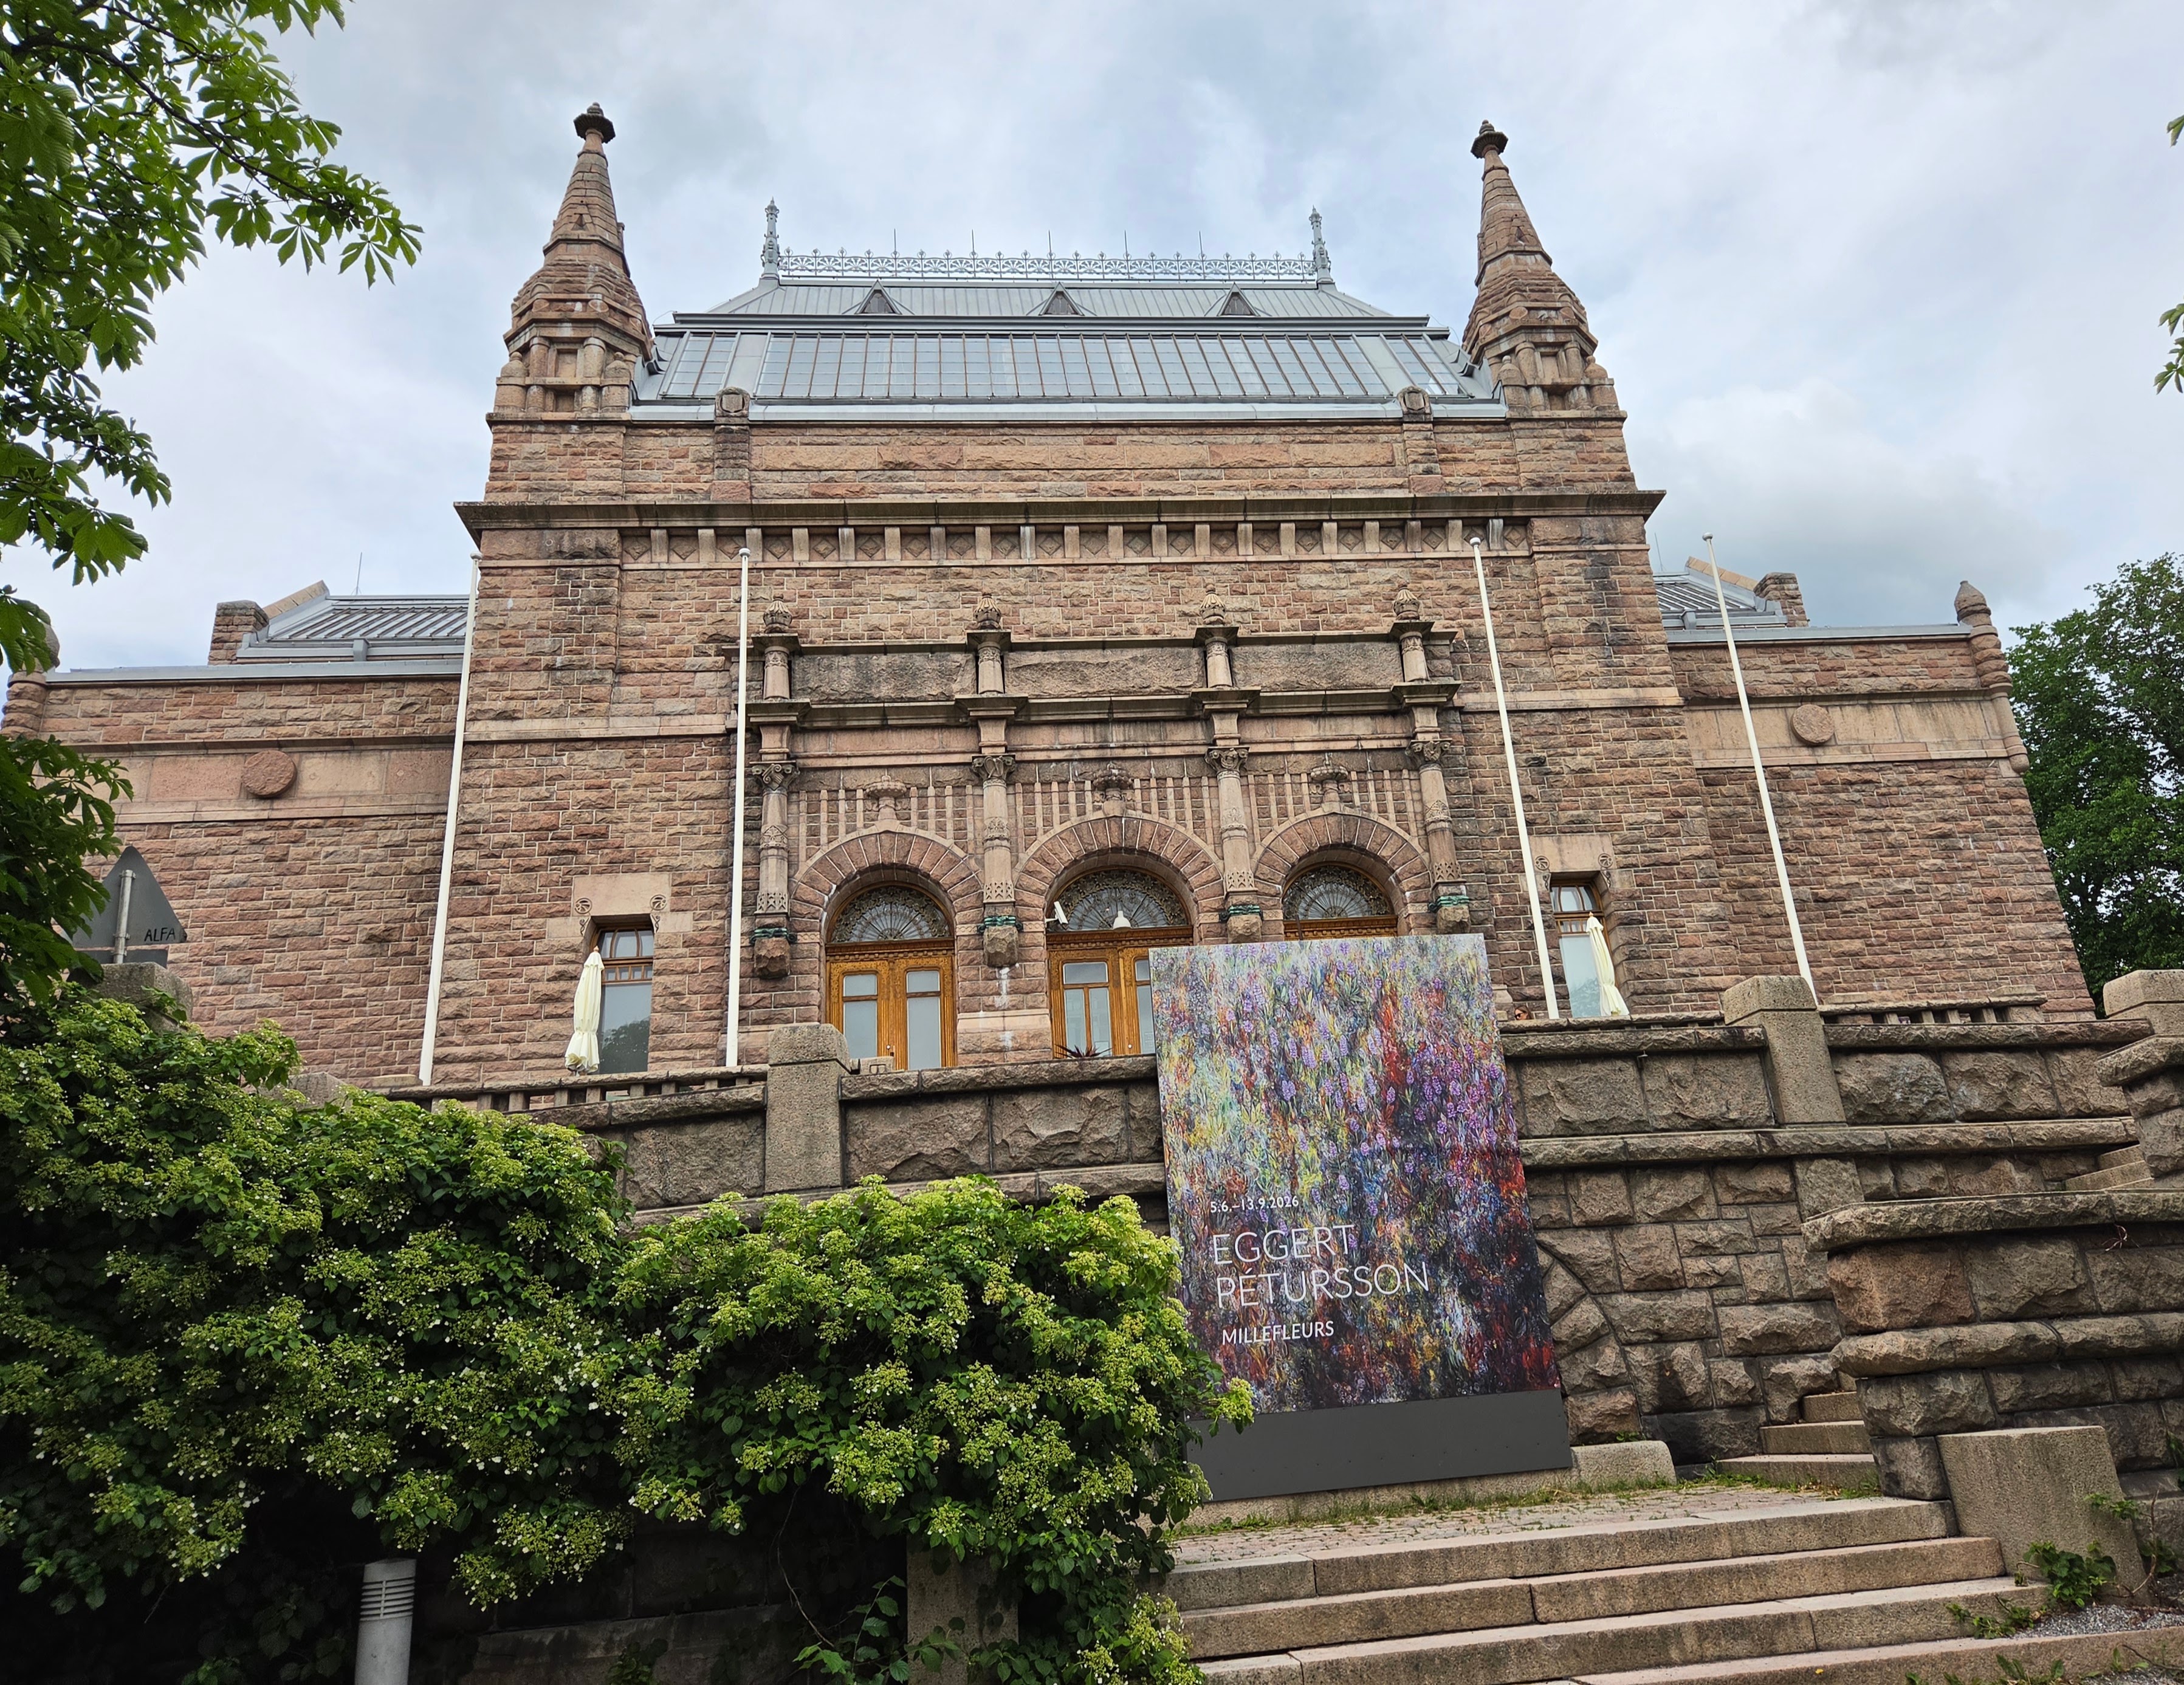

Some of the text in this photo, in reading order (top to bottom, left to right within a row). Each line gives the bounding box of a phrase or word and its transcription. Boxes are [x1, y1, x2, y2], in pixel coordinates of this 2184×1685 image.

[144, 927, 176, 941] ALFA
[1213, 1224, 1355, 1265] EGGERT
[1217, 1261, 1429, 1308] PÉTURSSON
[1223, 1321, 1334, 1345] MILLEFLEURS
